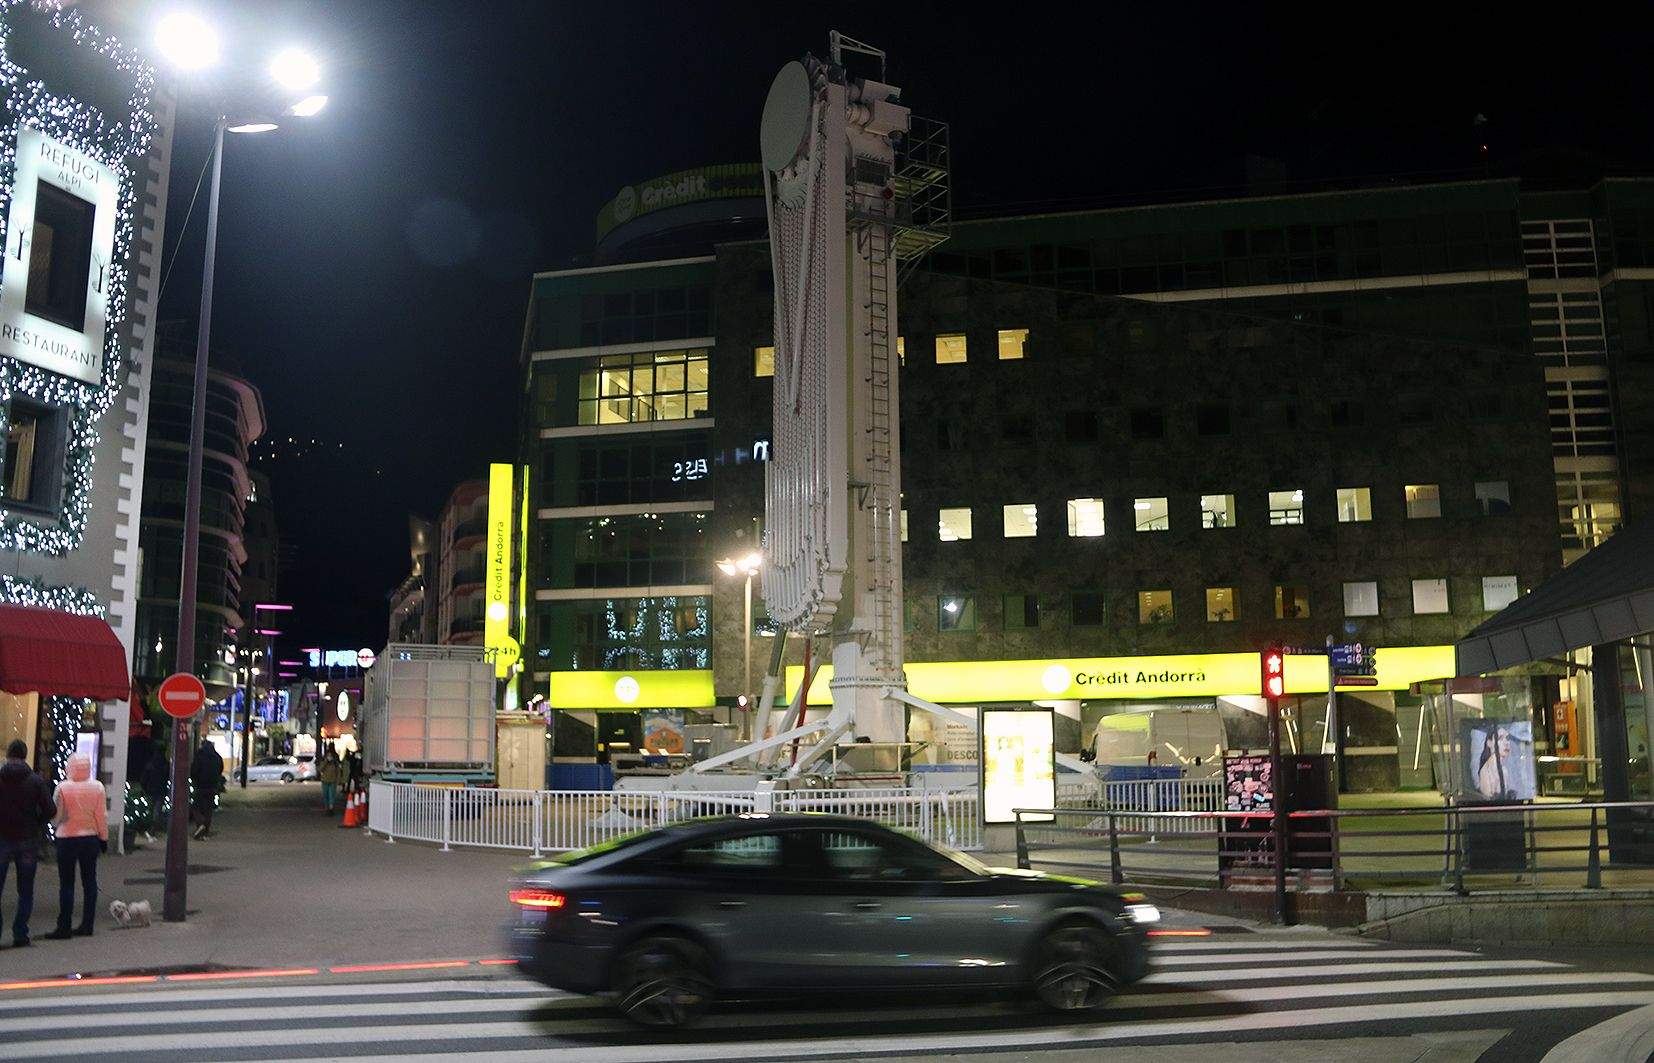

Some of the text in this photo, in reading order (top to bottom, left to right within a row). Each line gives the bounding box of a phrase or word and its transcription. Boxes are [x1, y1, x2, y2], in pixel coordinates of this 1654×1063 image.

[41, 143, 99, 184] REFUGI
[58, 171, 81, 188] ALPI
[2, 324, 98, 368] RESTAURANT
